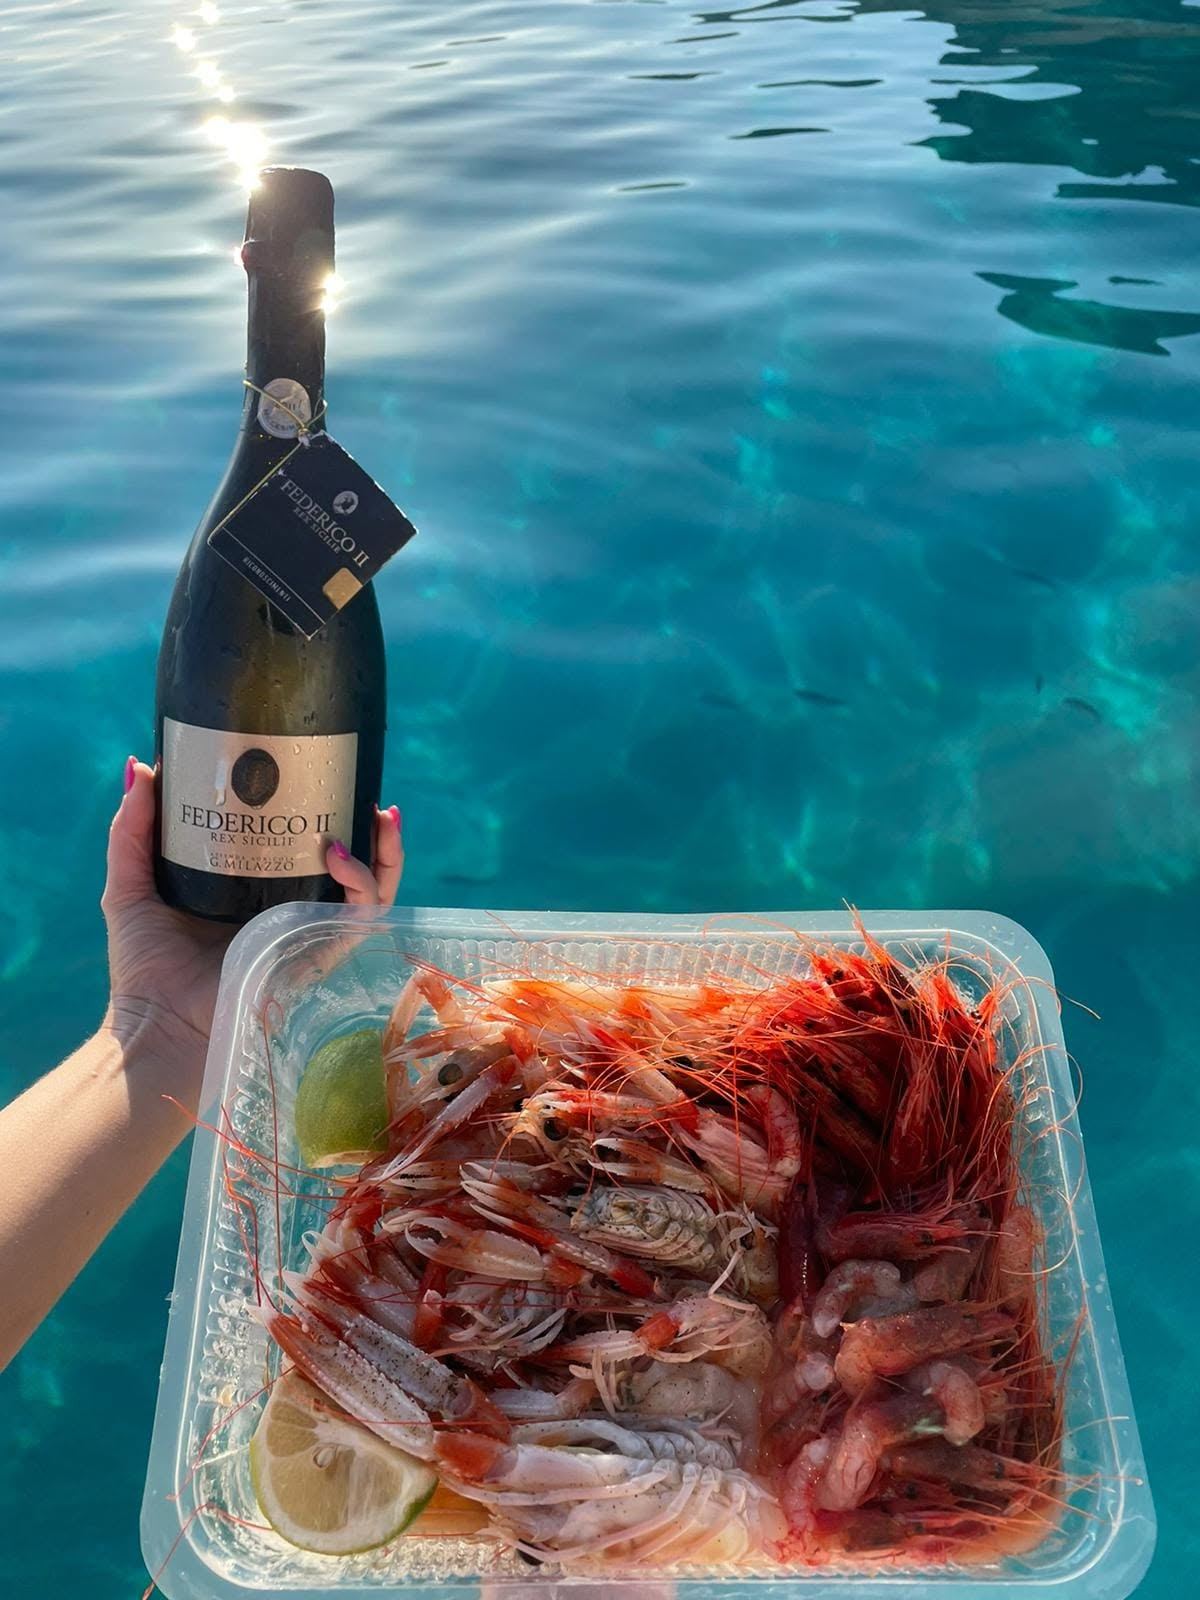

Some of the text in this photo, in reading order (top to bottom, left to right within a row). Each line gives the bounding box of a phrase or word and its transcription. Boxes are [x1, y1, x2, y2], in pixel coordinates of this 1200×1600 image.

[279, 479, 371, 568] FEDERICO II
[180, 804, 330, 835] FEDERICO II
[210, 831, 236, 844] REX
[209, 857, 294, 872] G. MILAZZO
